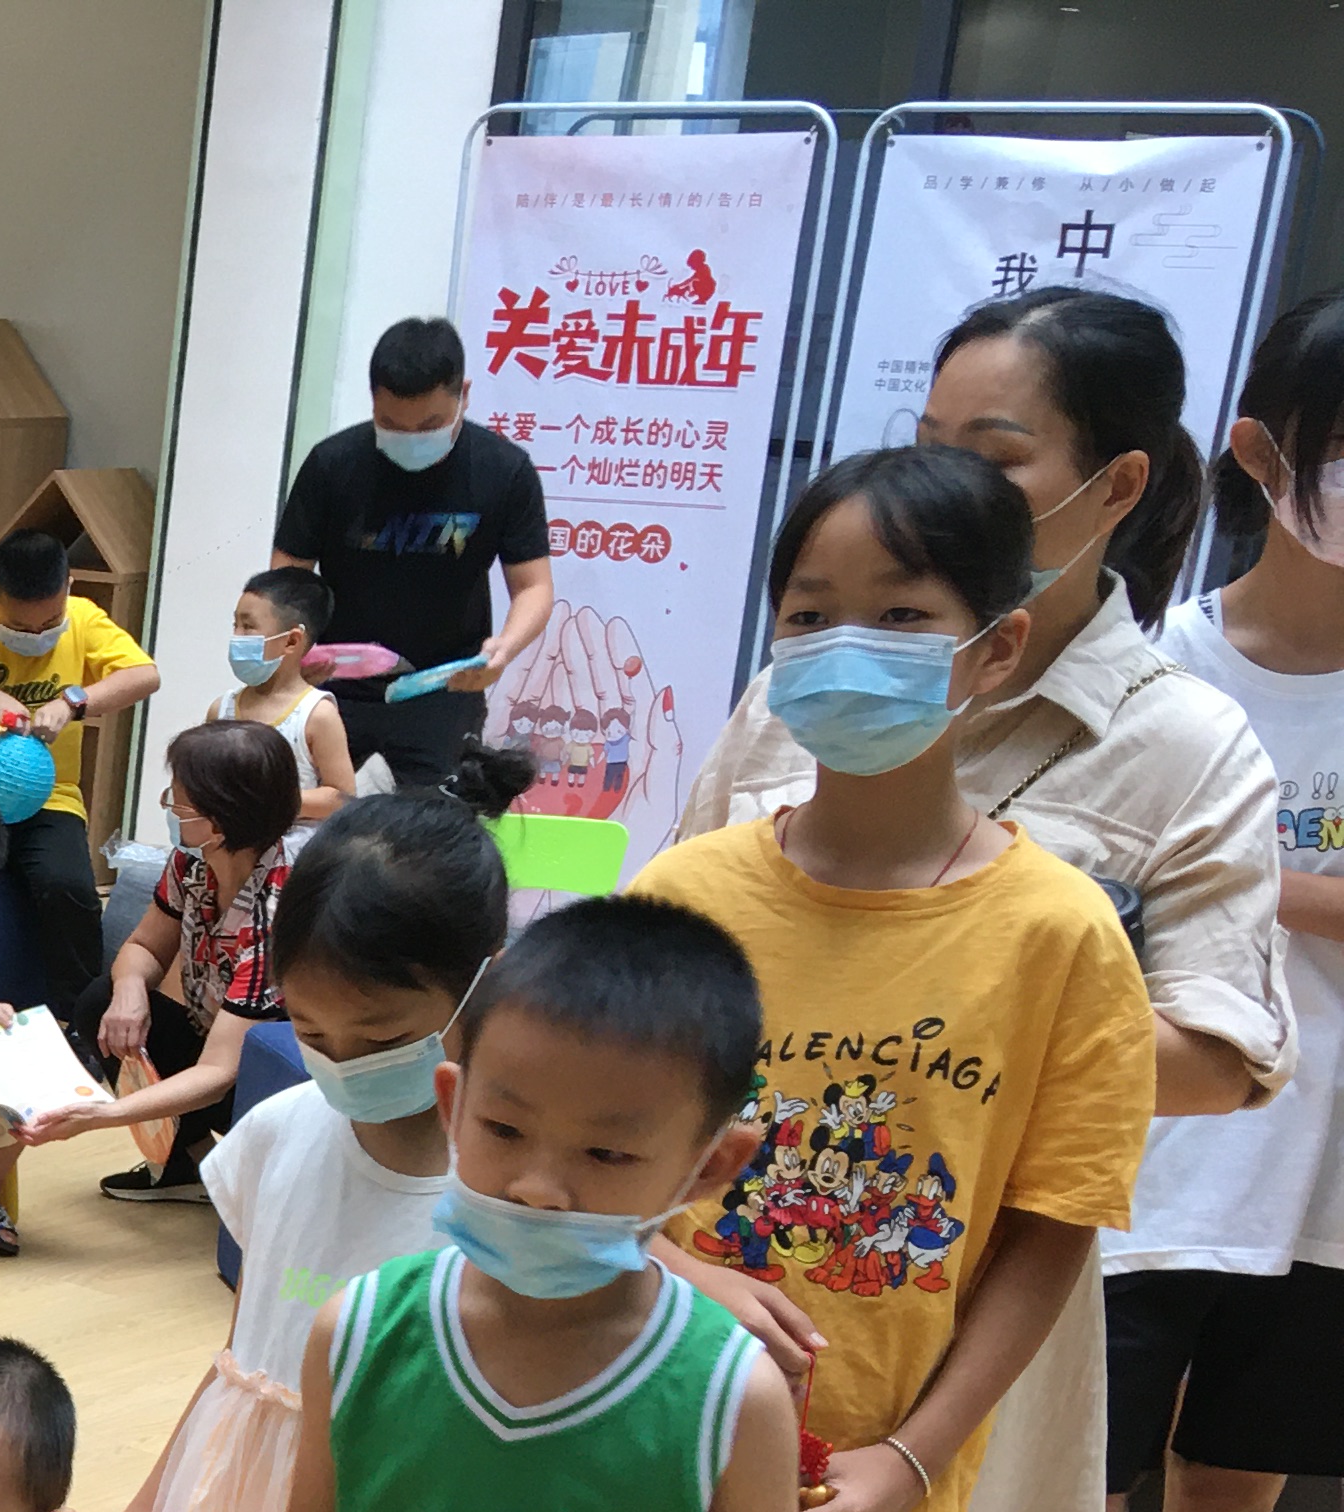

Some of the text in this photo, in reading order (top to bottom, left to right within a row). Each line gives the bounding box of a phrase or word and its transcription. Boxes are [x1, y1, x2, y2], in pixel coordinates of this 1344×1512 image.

[1056, 209, 1116, 278] 中
[584, 280, 631, 297] LOVE
[485, 286, 763, 389] 关爱未成年
[876, 359, 931, 375] 中国精神
[873, 377, 927, 394] 中国文化
[487, 411, 730, 451] 关爱一个成长的心灵
